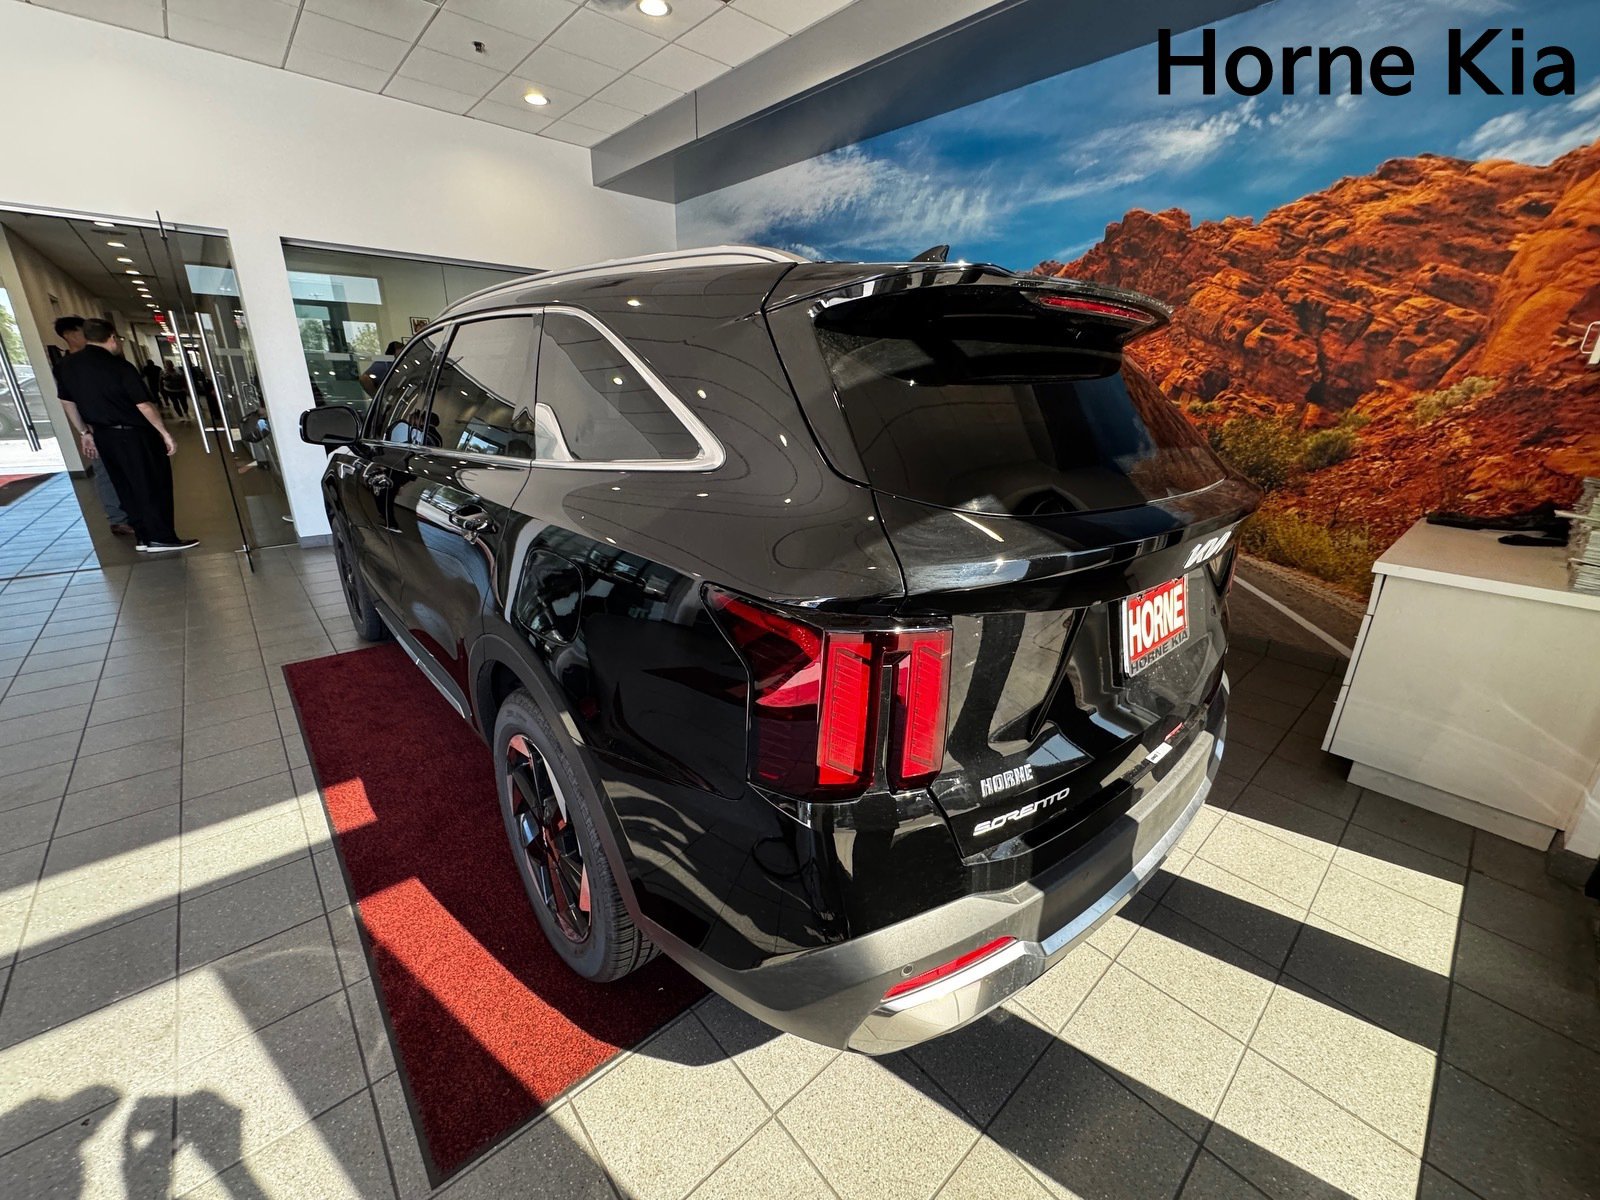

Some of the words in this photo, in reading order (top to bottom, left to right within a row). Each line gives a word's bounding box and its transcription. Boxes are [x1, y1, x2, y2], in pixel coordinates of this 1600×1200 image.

[1128, 583, 1184, 658] HORNE
[1130, 644, 1170, 674] HORNE
[1171, 630, 1188, 645] KIA
[980, 763, 1034, 798] HORNE
[973, 787, 1071, 837] SORENTO
